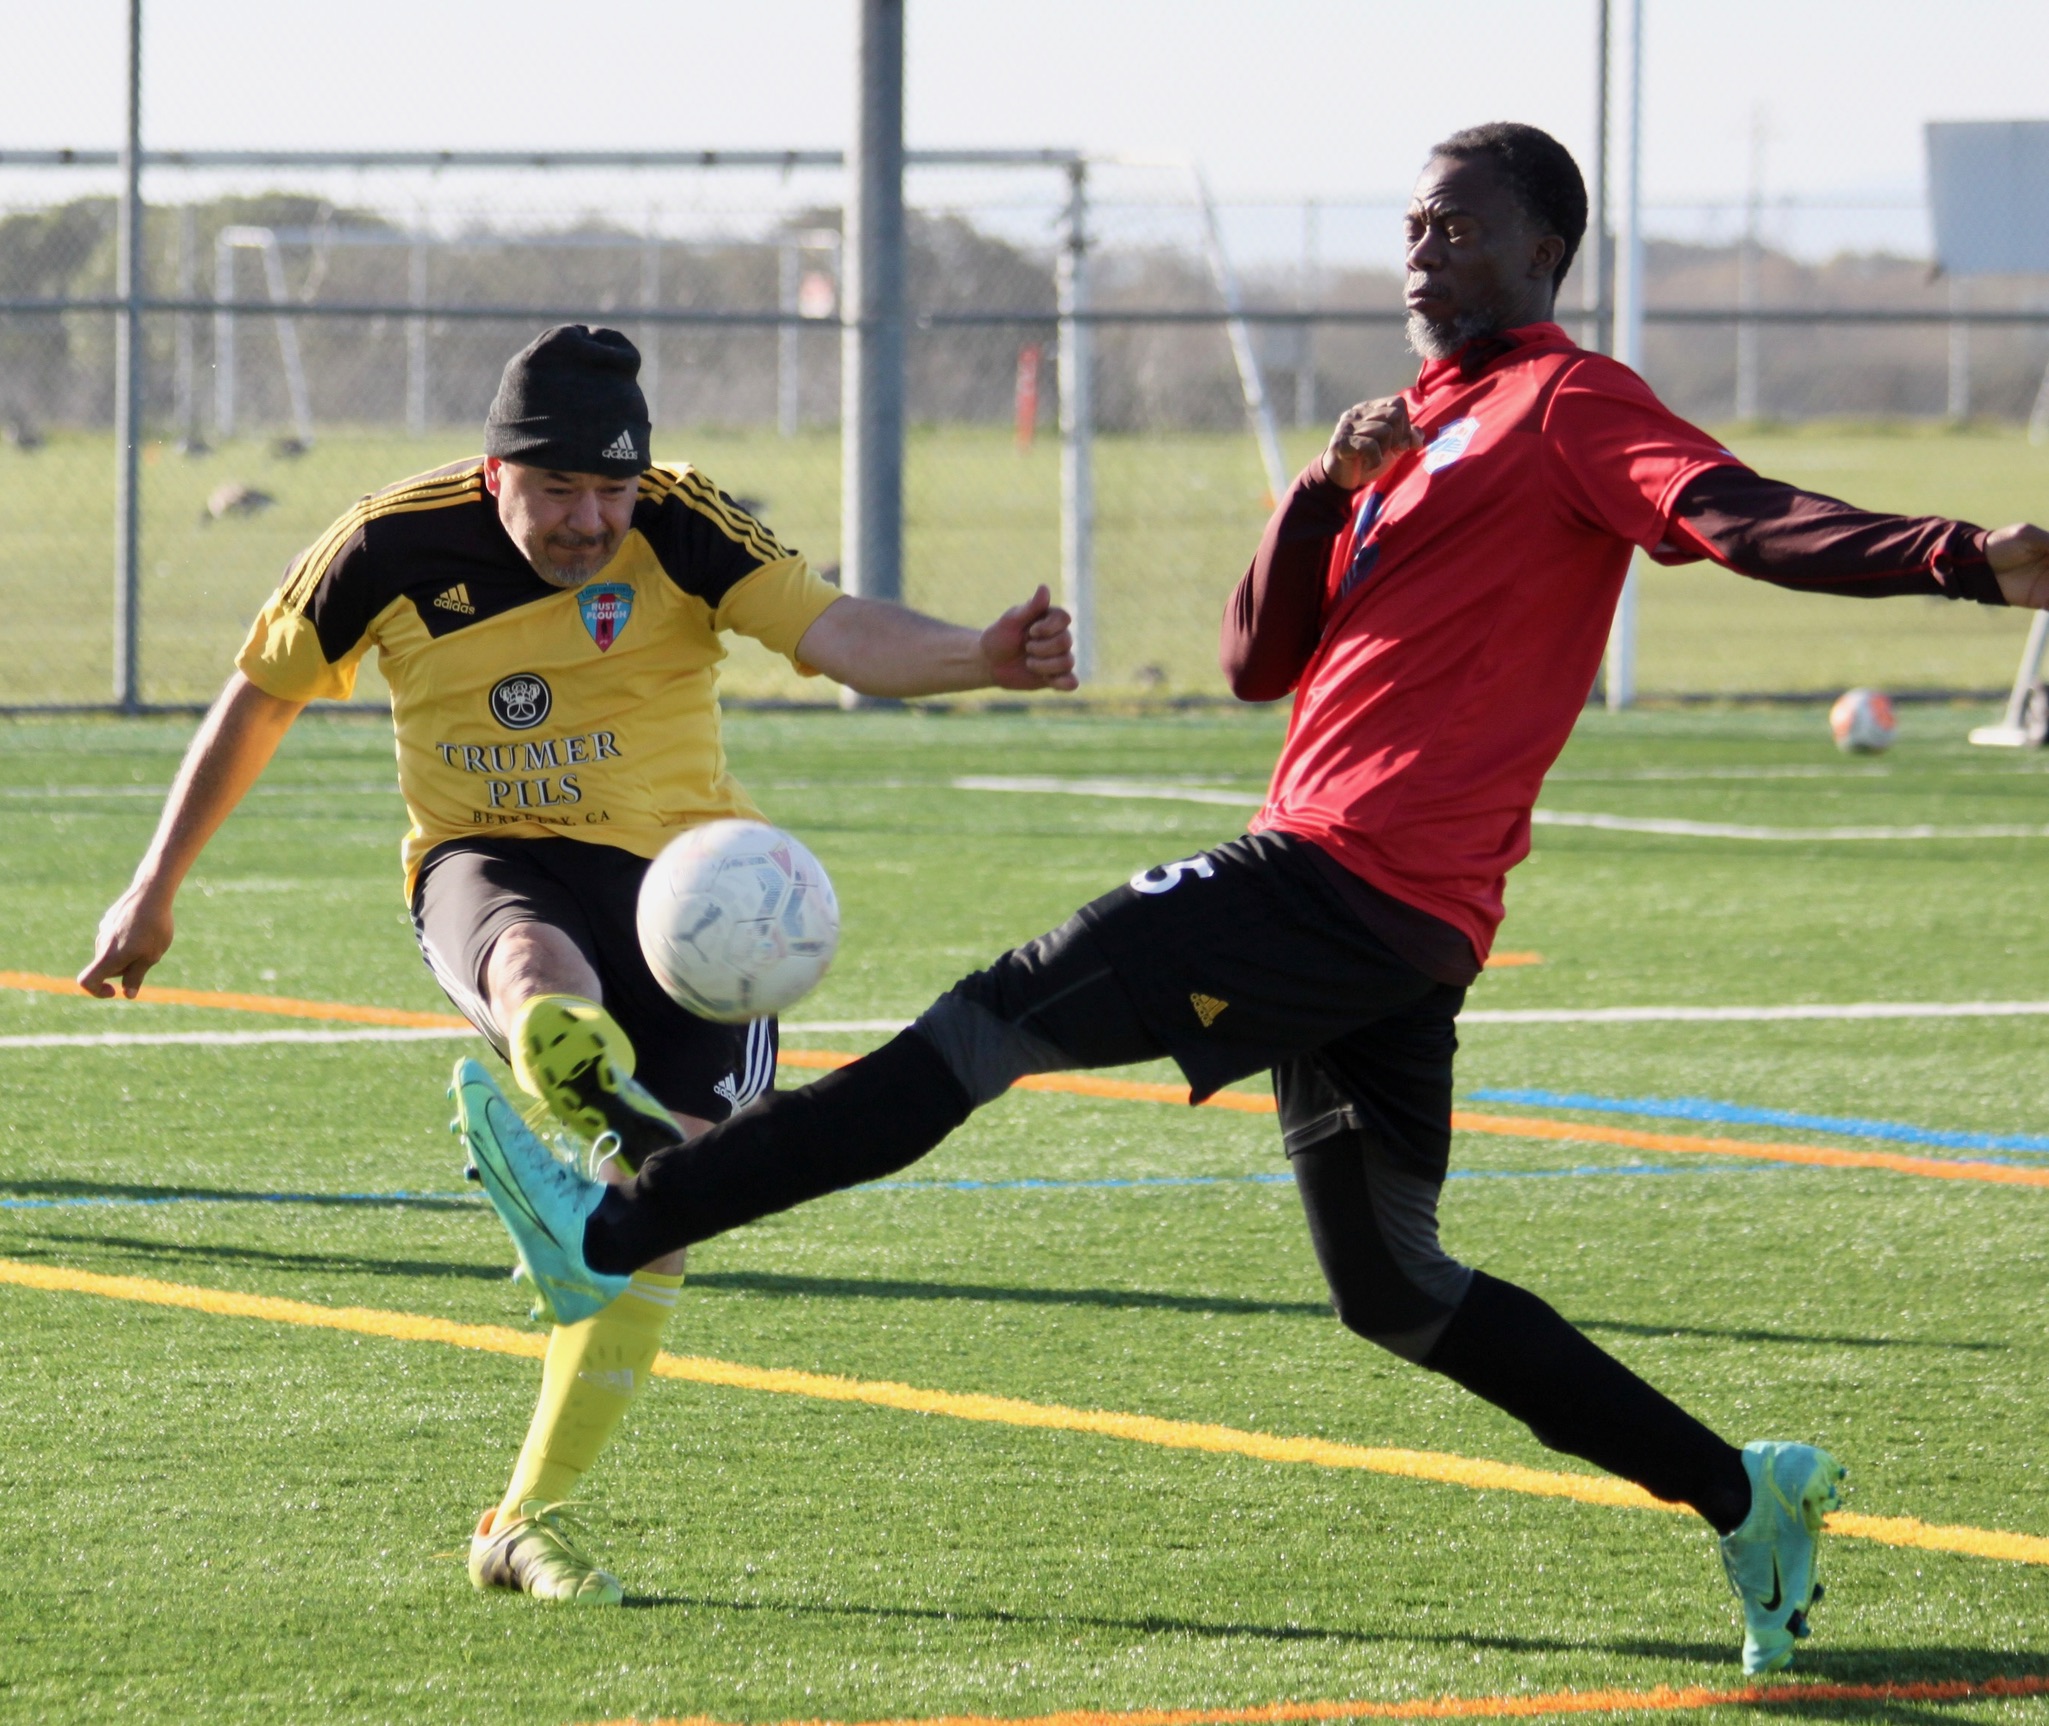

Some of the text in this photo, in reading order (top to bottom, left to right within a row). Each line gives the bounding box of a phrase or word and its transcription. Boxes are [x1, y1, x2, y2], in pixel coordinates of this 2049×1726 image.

[433, 597, 476, 615] adidas
[586, 610, 627, 620] PLOUGH
[591, 602, 622, 611] RUSTY
[436, 731, 622, 774] TRUMER
[485, 773, 582, 809] PILS
[585, 810, 610, 824] CA
[1130, 857, 1215, 894] 5
